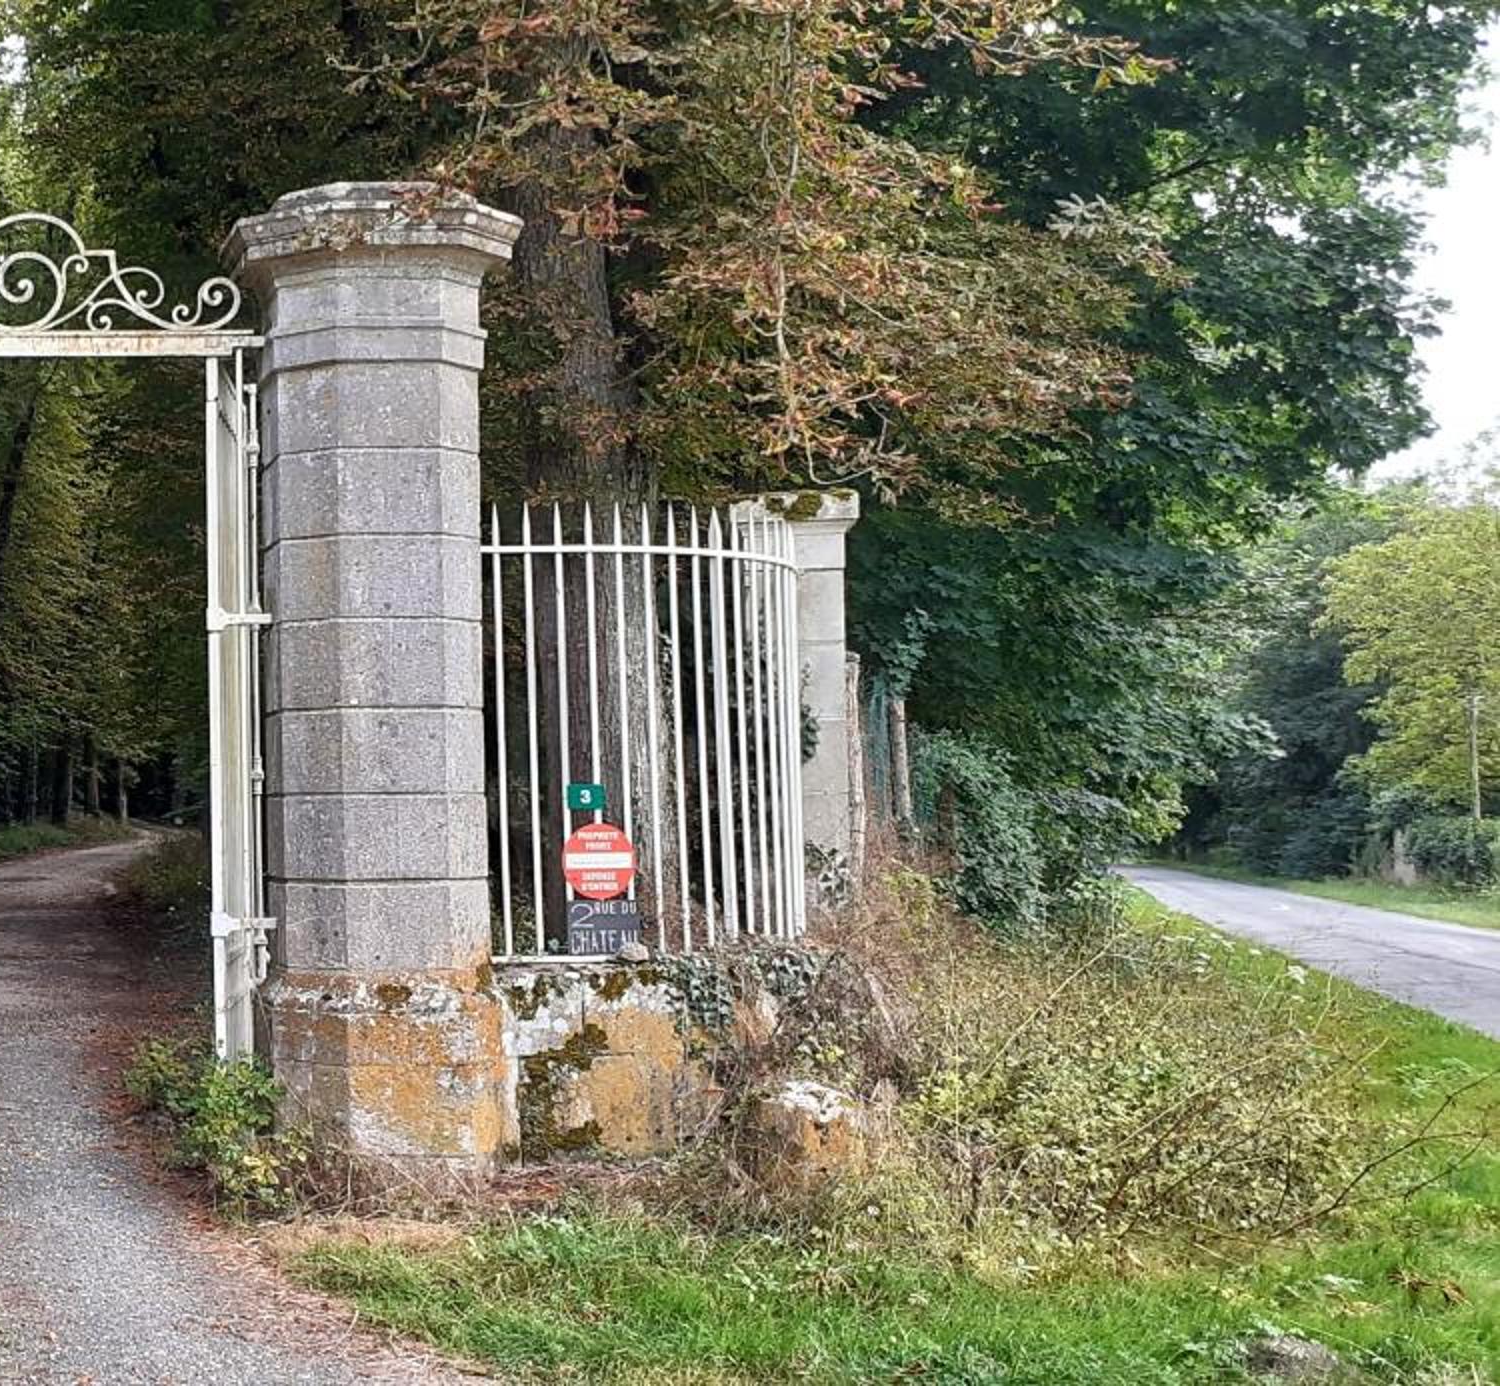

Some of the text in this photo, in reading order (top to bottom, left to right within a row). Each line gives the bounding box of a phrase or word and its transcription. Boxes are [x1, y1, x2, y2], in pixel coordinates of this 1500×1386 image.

[580, 789, 592, 804] 3
[571, 901, 637, 928] 2 RUE DU
